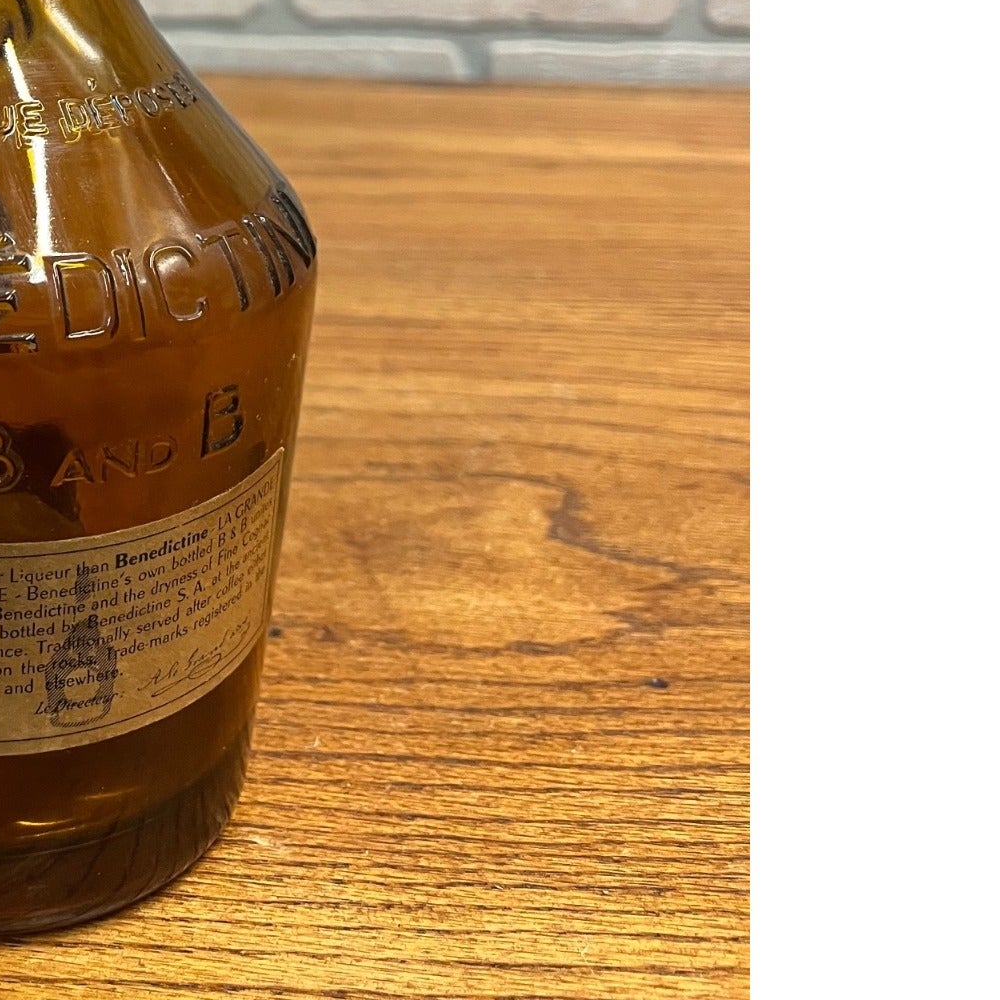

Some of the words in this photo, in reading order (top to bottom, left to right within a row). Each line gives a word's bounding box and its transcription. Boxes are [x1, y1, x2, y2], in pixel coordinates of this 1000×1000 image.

[50, 435, 178, 488] AND
[201, 384, 243, 458] B
[10, 568, 71, 584] Liqueur
[76, 561, 109, 577] than
[115, 528, 209, 569] Benedictine
[218, 512, 232, 530] LA
[27, 571, 132, 601] Benedictine's
[138, 565, 165, 581] own
[171, 539, 213, 570] bottled
[218, 532, 226, 547] B
[230, 526, 237, 540] &
[240, 517, 248, 533] B
[91, 592, 118, 611] and
[124, 588, 145, 602] the
[151, 569, 198, 595] dryness
[201, 555, 213, 574] of
[218, 546, 238, 566] Fine
[0, 622, 55, 639] bottled
[62, 620, 77, 636] by
[88, 599, 171, 629] Benedictine
[177, 588, 189, 603] S.
[193, 580, 206, 596] A.
[212, 571, 222, 586] at
[226, 560, 240, 577] the
[21, 660, 46, 674] the
[52, 653, 98, 671] rocks.
[107, 625, 188, 660] Trade-marks
[194, 591, 242, 630] registered
[36, 626, 130, 655] Traditionally
[137, 607, 180, 634] served
[186, 595, 212, 618] after
[216, 572, 245, 599] coffee
[4, 678, 34, 694] and
[45, 669, 123, 691] elsewhere.
